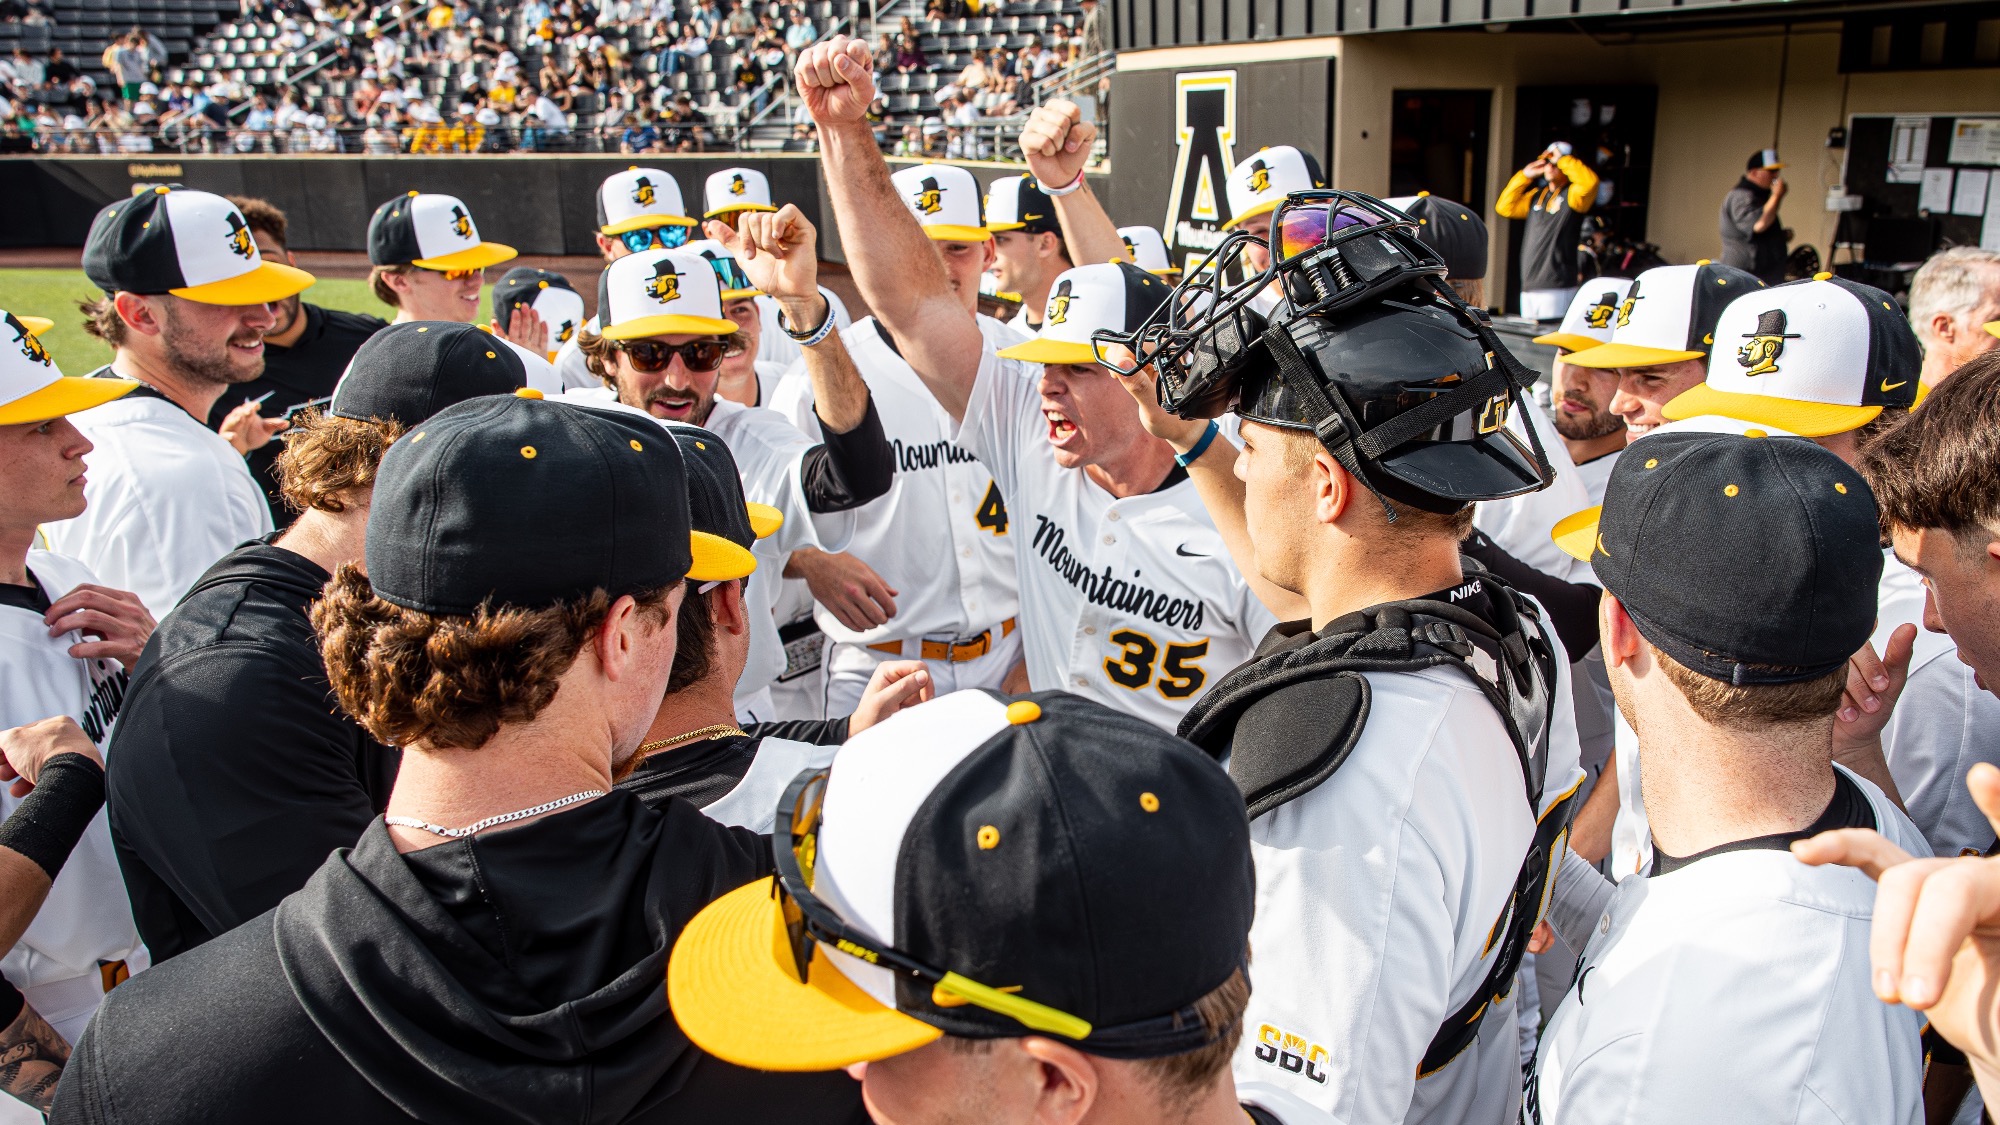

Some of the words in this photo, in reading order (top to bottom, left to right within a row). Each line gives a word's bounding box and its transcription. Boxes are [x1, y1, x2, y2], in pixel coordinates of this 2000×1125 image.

[1032, 514, 1204, 631] Mountaineers
[1450, 579, 1482, 603] NIKE
[1102, 627, 1211, 700] 35
[836, 938, 879, 964] 100%
[1254, 1023, 1330, 1084] SBC
